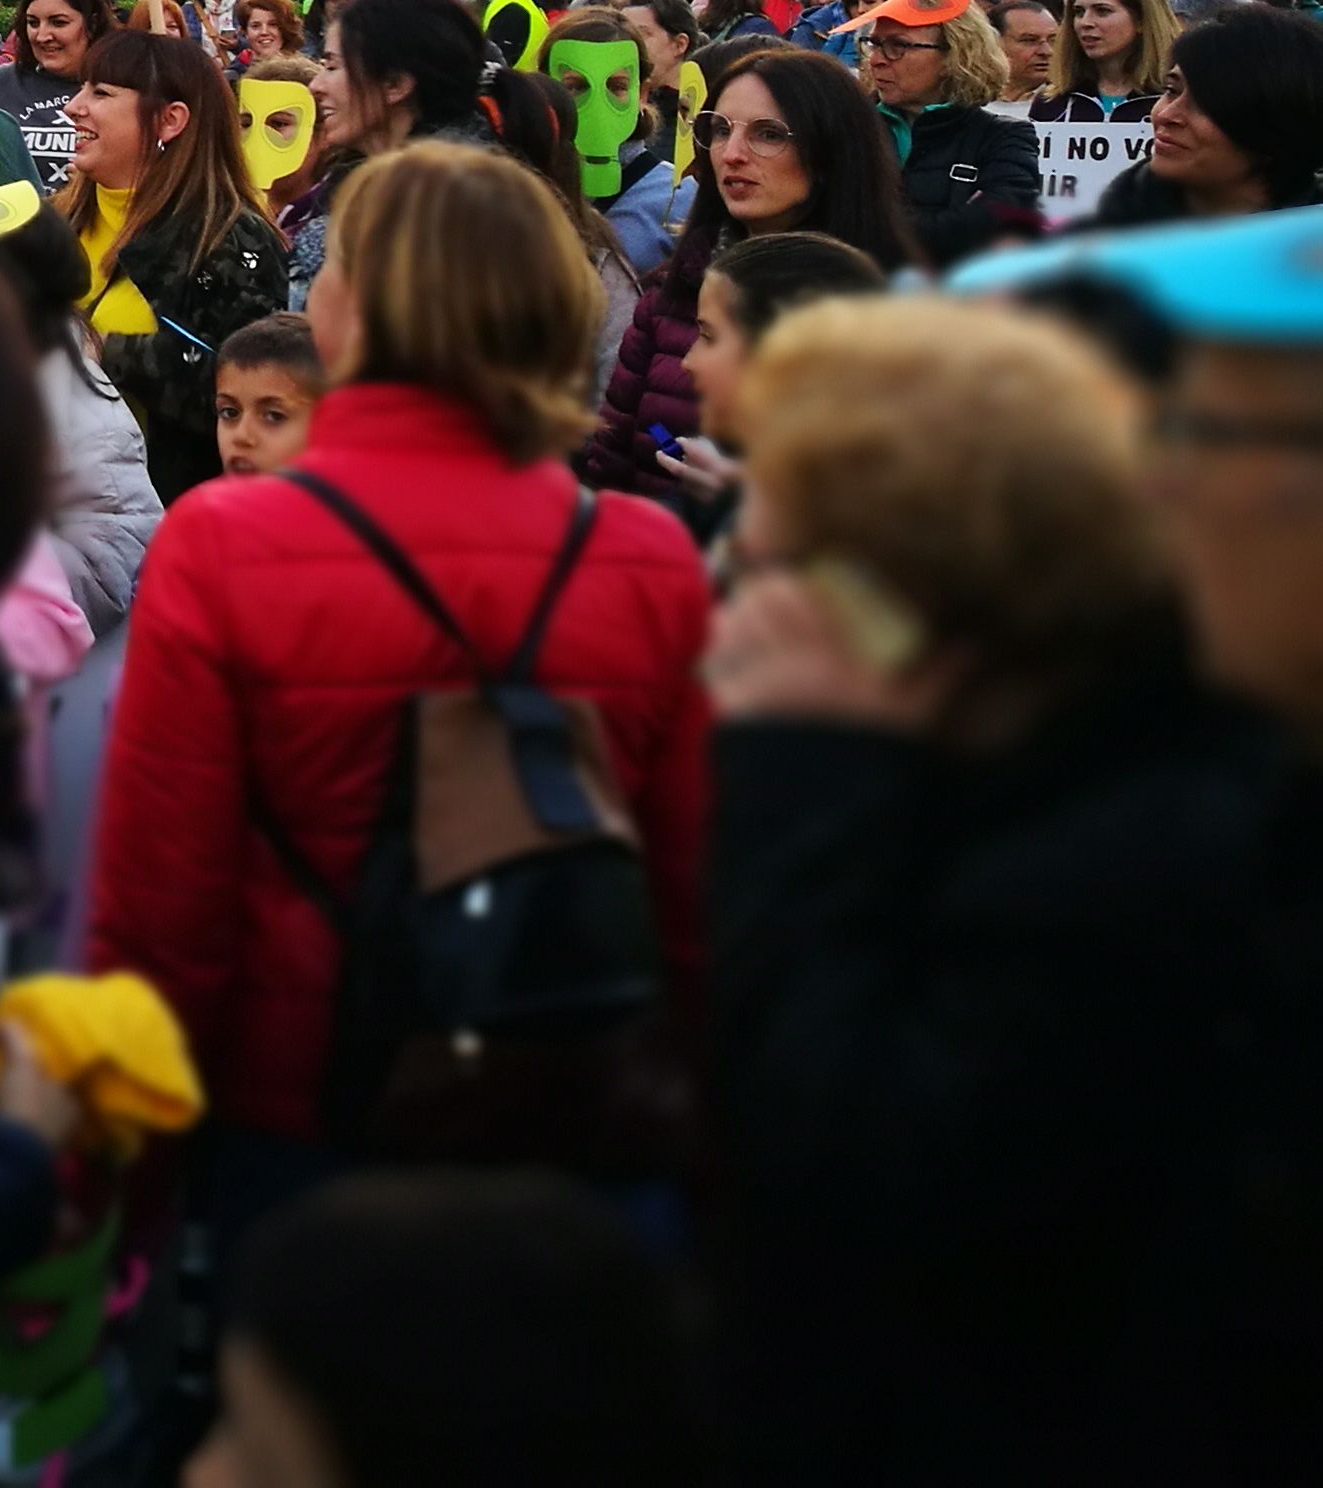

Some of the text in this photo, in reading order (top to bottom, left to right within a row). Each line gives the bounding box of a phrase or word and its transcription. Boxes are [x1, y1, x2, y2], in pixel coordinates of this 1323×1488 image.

[19, 106, 35, 120] LA
[34, 95, 70, 110] MARC
[1067, 136, 1110, 161] NO
